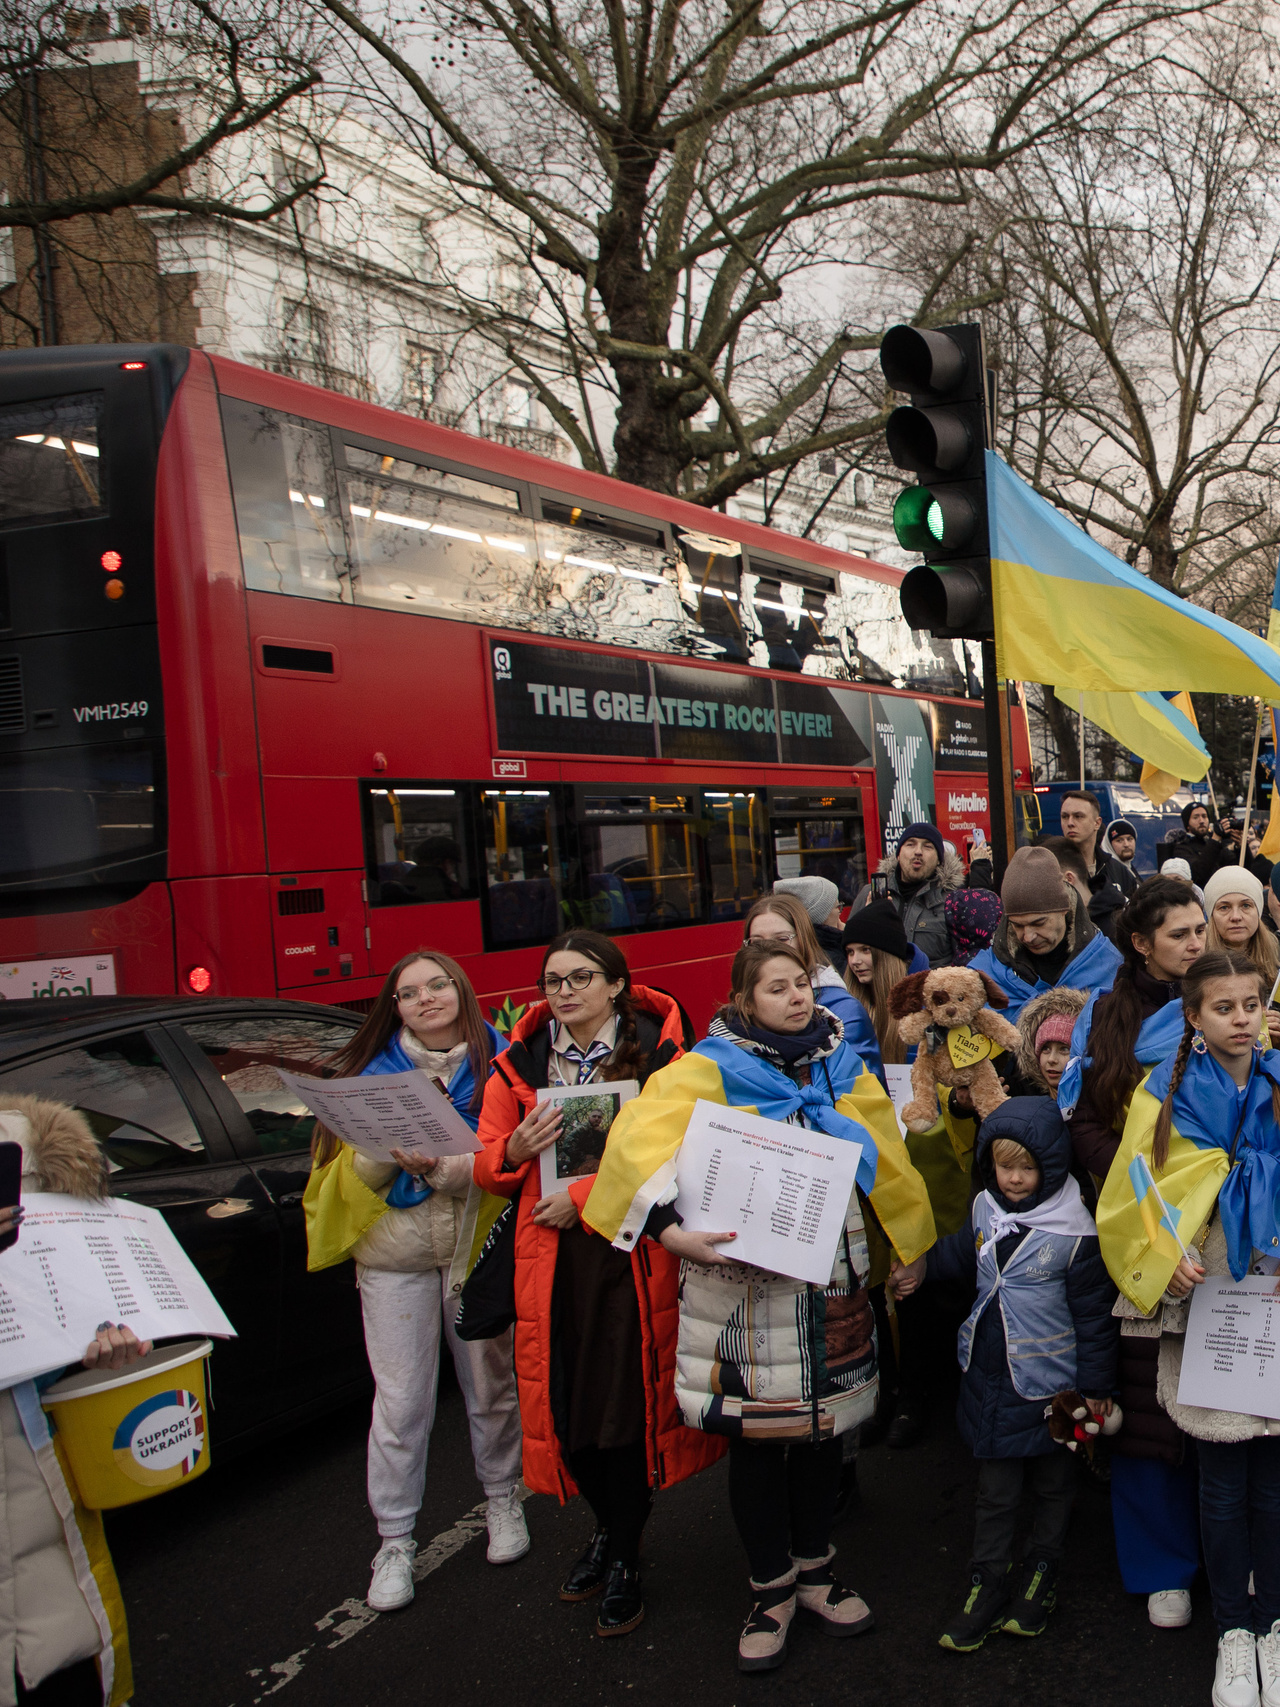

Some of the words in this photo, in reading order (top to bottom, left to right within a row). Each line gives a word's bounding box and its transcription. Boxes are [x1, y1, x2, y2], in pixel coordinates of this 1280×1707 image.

[73, 700, 149, 722] VMH2549
[527, 683, 588, 718] THE
[593, 690, 718, 729] GREATEST
[724, 704, 776, 733] ROCK
[781, 711, 832, 738] EVER!
[876, 723, 894, 733] RADIO
[500, 763, 520, 774] global
[948, 792, 987, 812] Metroline
[285, 946, 316, 955] COOLANT
[957, 1034, 980, 1052] Tiana
[137, 1417, 190, 1447] SUPPORT
[140, 1428, 192, 1458] UKRAINE
